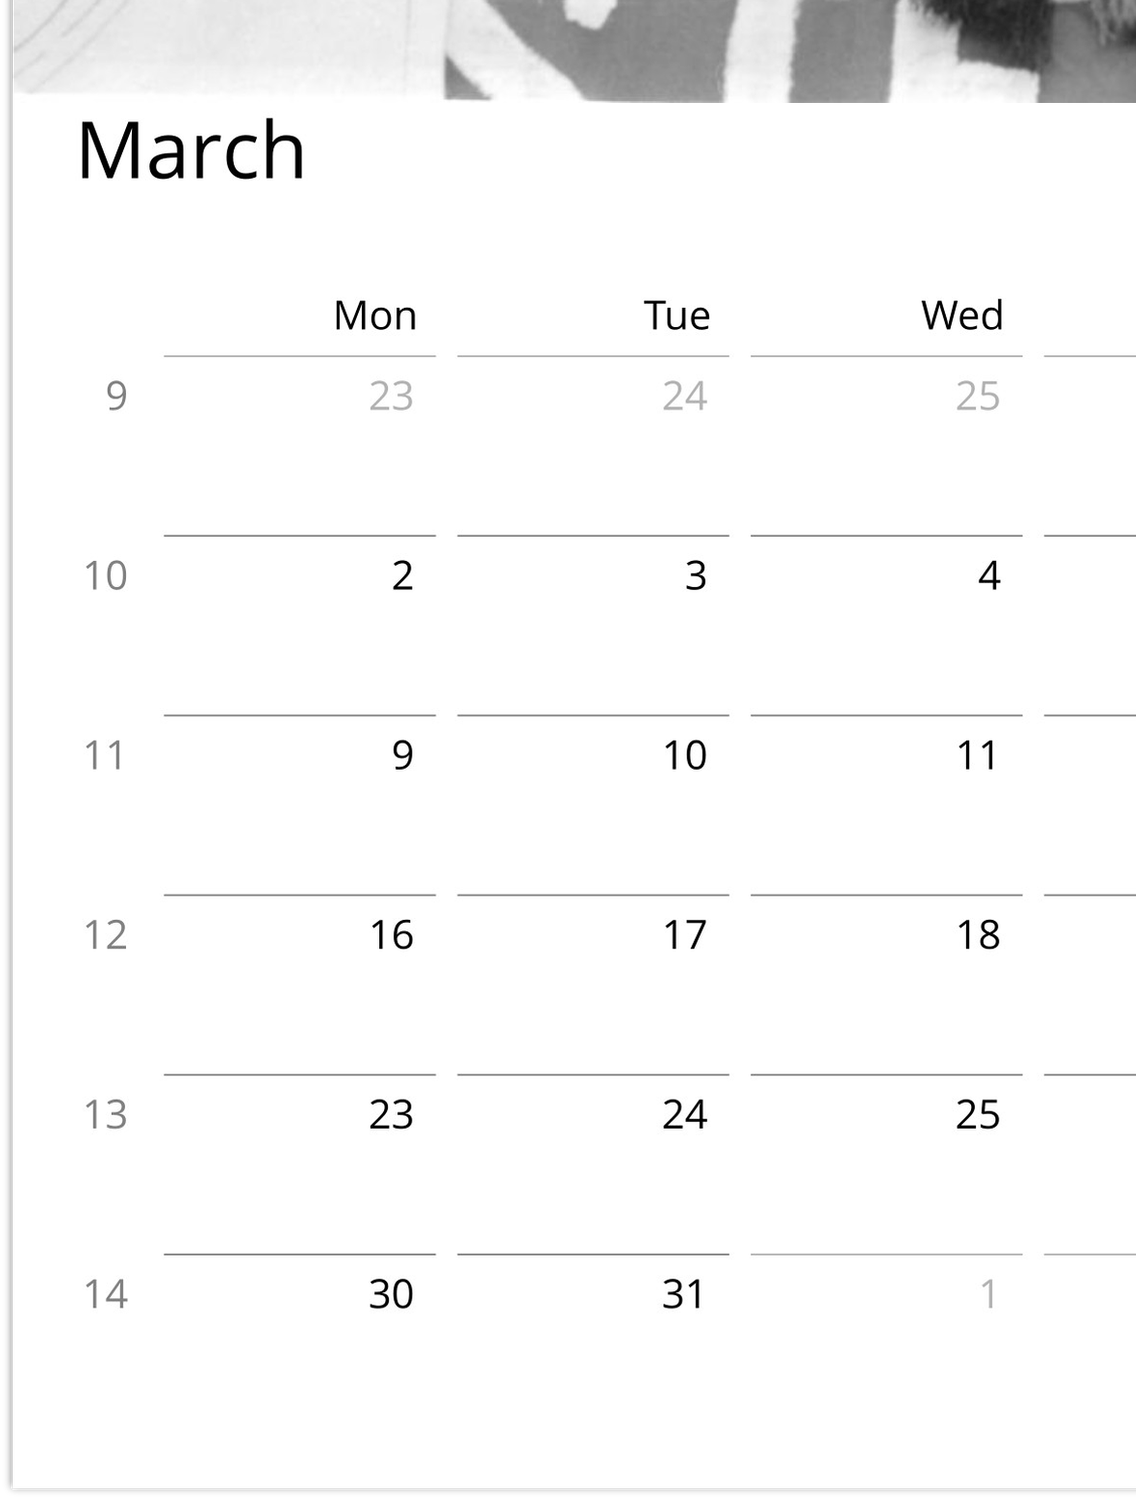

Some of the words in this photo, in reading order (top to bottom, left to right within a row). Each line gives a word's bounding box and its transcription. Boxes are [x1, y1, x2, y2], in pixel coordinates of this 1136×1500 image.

[81, 117, 303, 181] March
[335, 299, 416, 331] Mon
[643, 299, 711, 331] Tue
[920, 297, 1003, 331] Wed
[106, 379, 127, 412] 9
[369, 380, 413, 411] 23
[663, 380, 708, 411] 24
[956, 380, 1000, 411] 25
[85, 559, 127, 591] 10
[392, 559, 414, 591] 2
[685, 559, 707, 591] 3
[977, 559, 1002, 591] 4
[85, 739, 121, 771] 11
[392, 739, 414, 771] 9
[664, 739, 707, 771] 10
[958, 739, 994, 771] 11
[85, 919, 127, 950] 12
[371, 918, 414, 951] 16
[664, 919, 707, 950] 17
[958, 918, 1001, 951] 18
[85, 1098, 127, 1130] 13
[369, 1098, 414, 1130] 23
[662, 1098, 709, 1130] 24
[956, 1098, 1000, 1130] 25
[85, 1278, 129, 1309] 14
[369, 1277, 414, 1310] 30
[662, 1277, 701, 1310] 31
[981, 1278, 993, 1309] 1
